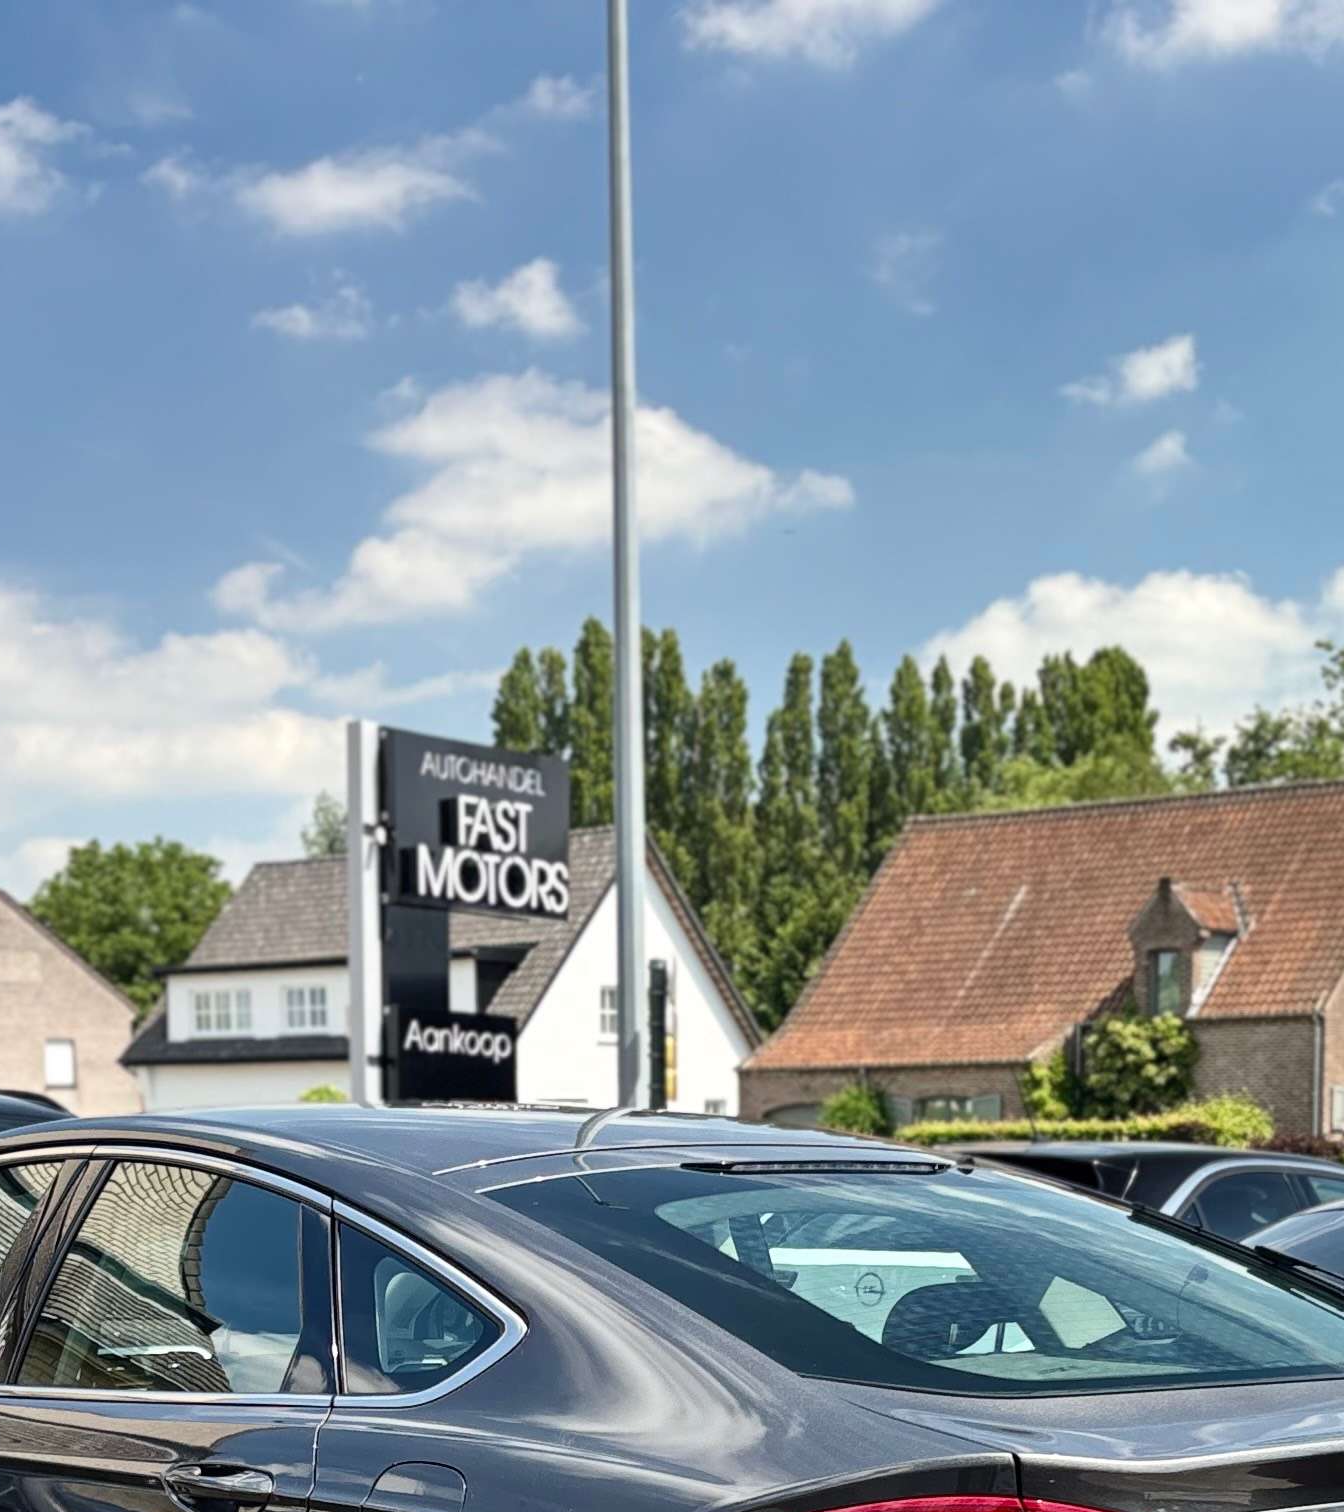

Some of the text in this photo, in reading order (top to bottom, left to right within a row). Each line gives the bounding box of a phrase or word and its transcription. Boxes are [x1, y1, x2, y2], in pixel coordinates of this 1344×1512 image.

[420, 751, 546, 797] AUTOHANDEL
[457, 793, 533, 854] FAST
[417, 842, 570, 913] MOTORS
[403, 1019, 513, 1065] Aankoop
